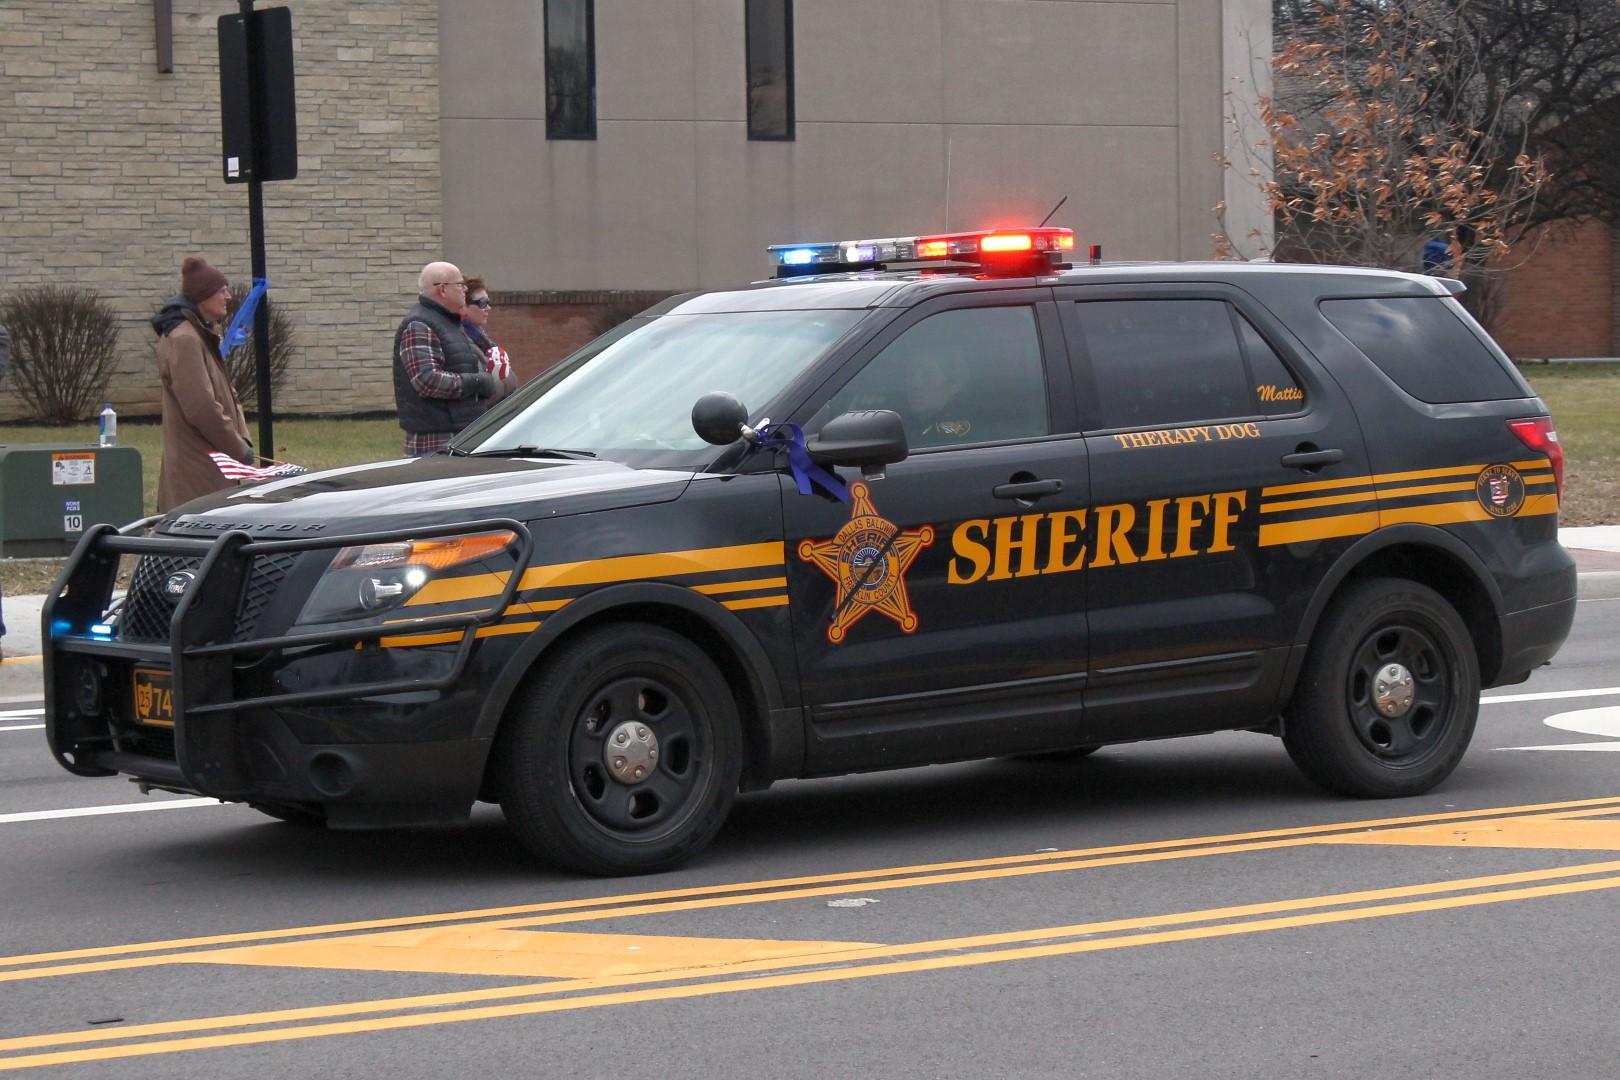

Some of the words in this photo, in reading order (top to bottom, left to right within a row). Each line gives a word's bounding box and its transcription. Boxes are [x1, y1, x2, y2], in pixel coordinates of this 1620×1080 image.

[1257, 384, 1304, 402] Mattis
[1114, 426, 1211, 449] THERAPY
[1215, 422, 1262, 440] DOG
[66, 516, 81, 529] 10
[838, 519, 864, 542] DALLAS
[947, 490, 1247, 584] SHERIFF
[167, 575, 187, 593] Ford
[874, 574, 897, 600] COUNTY
